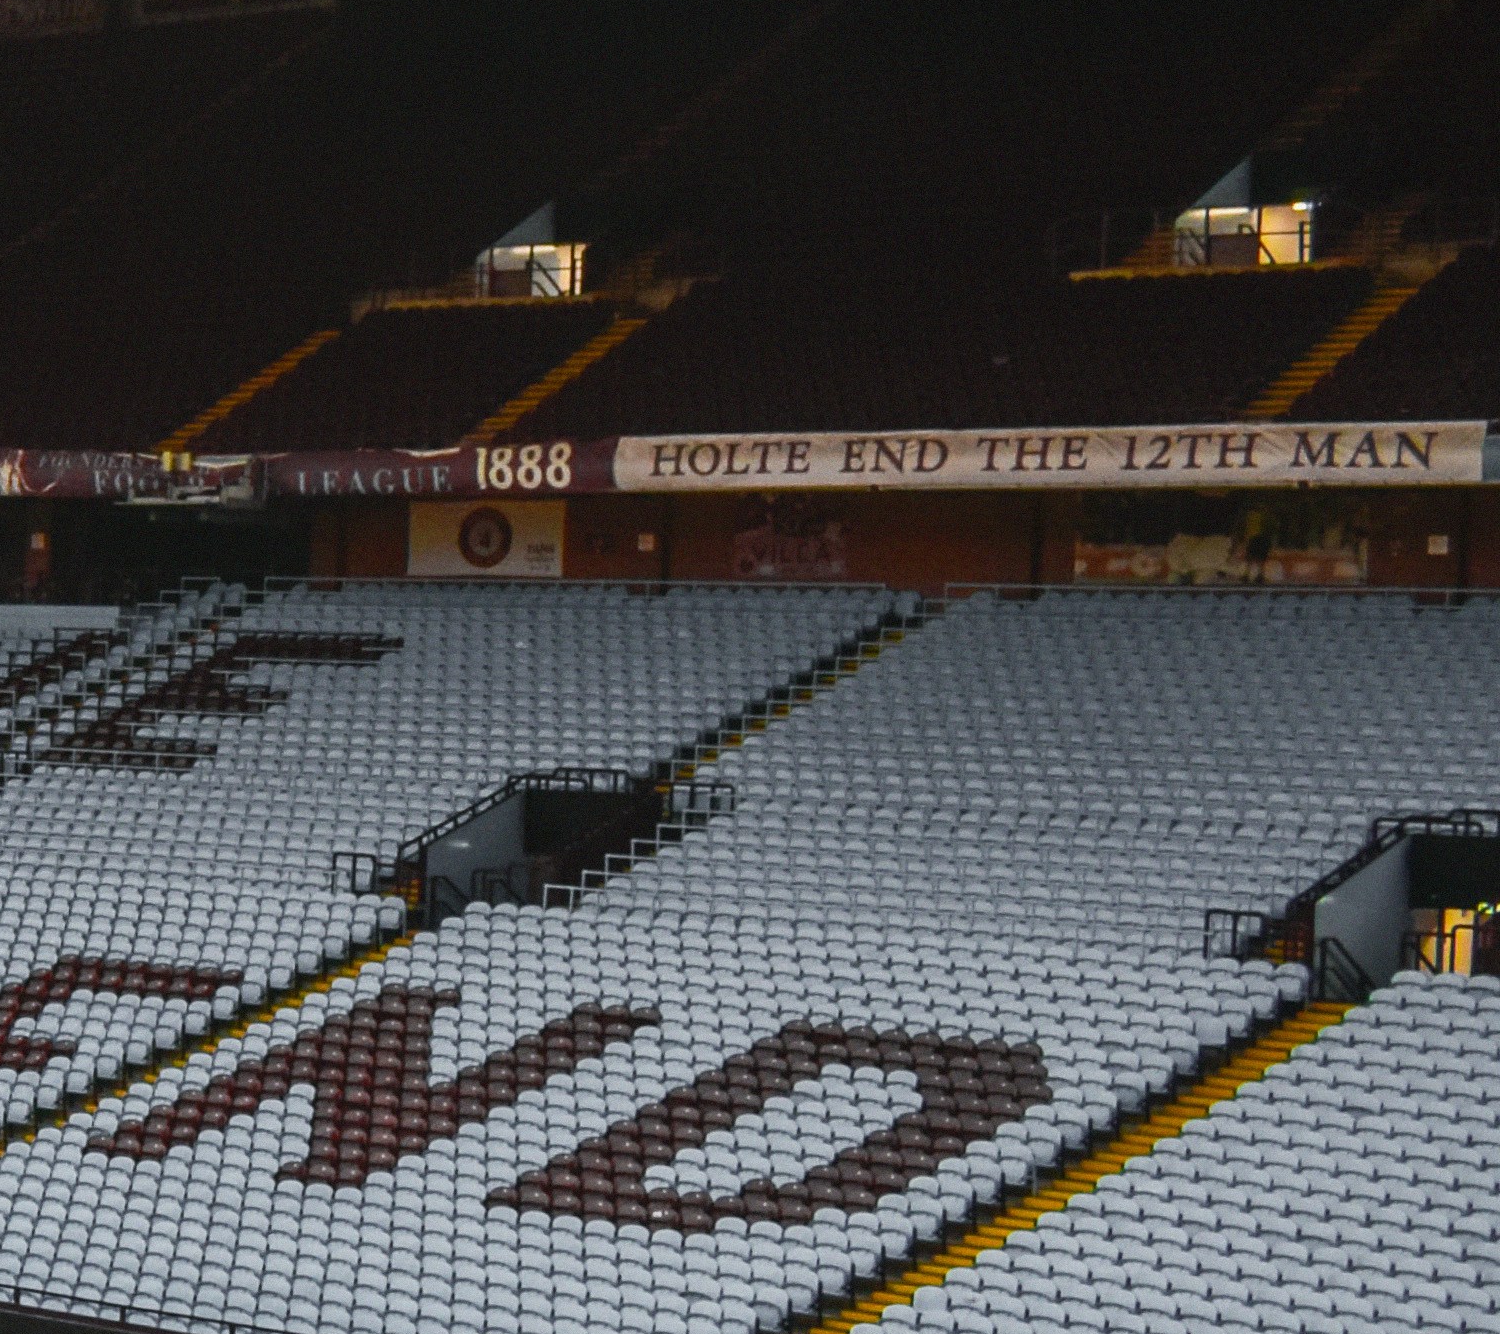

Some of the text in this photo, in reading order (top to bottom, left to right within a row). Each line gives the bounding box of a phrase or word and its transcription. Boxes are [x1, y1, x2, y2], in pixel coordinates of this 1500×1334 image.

[298, 464, 457, 496] LEAGUE
[476, 441, 573, 491] 1888
[650, 429, 1440, 478] HOLTE END THE 12TH MAN
